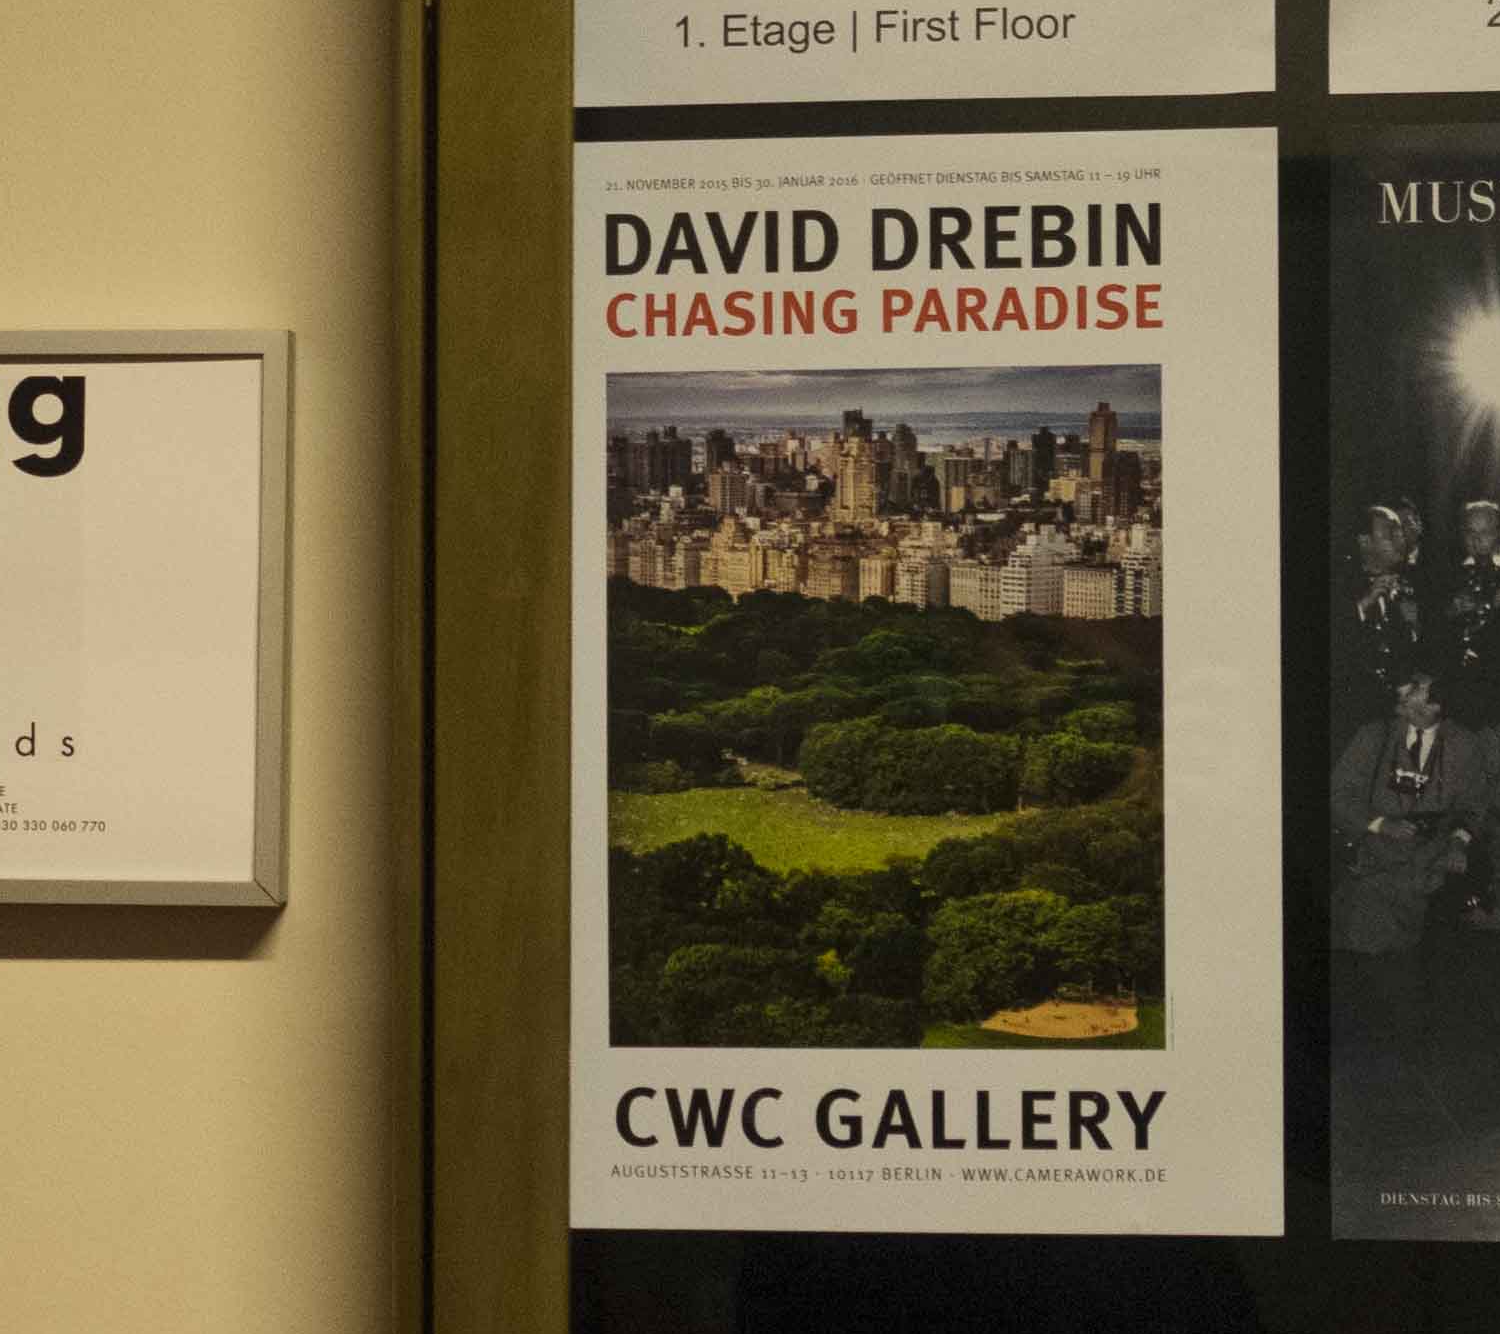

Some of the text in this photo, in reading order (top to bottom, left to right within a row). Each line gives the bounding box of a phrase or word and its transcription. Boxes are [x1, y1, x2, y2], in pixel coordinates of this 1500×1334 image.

[675, 15, 705, 48] 1.
[722, 13, 836, 55] Etage
[875, 9, 960, 43] First
[975, 6, 1076, 41] Floor
[605, 181, 623, 192] 21.
[626, 177, 696, 191] NOVEMBER
[699, 179, 729, 192] 2015
[731, 176, 753, 190] BIS
[755, 178, 775, 192] 30.
[778, 174, 825, 188] JANUAR
[828, 175, 859, 187] 2016
[869, 172, 933, 186] GEÖFFNET
[935, 171, 998, 185] DIENSTAG
[1000, 170, 1023, 183] BIS
[1024, 169, 1085, 182] SAMSTAG
[1088, 171, 1101, 182] 11
[1116, 170, 1131, 183] 19
[1134, 167, 1161, 180] UHR
[605, 202, 1162, 276] DAVID DREBIN
[605, 283, 1164, 339] CHASING PARADISE
[22, 819, 48, 832] 330
[51, 819, 78, 832] 060
[81, 819, 107, 833] 770
[615, 1086, 1167, 1151] CWC GALLERY
[610, 1164, 1165, 1183] AUGUSTSTRASSE 11-13 10117 BERLIN WWW.CAMERAWORK.DE
